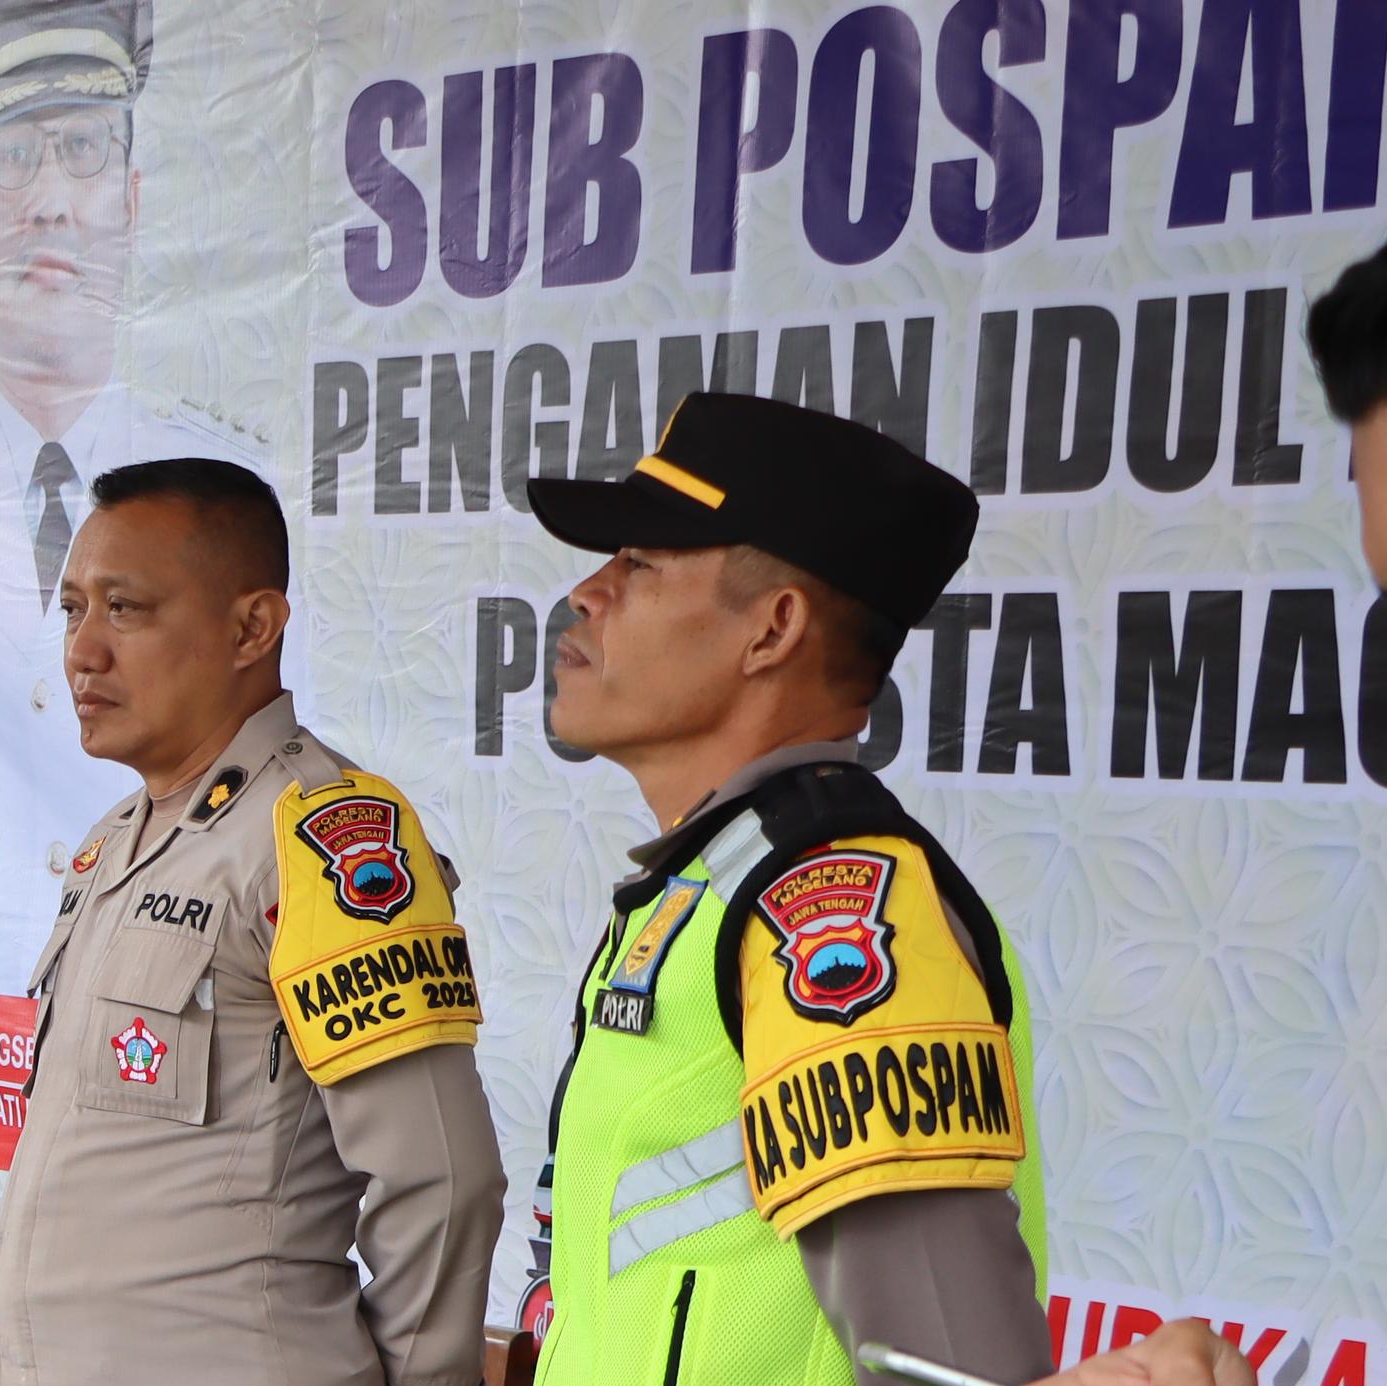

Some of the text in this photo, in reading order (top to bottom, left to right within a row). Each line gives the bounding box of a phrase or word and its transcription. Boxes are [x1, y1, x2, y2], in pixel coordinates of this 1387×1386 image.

[342, 51, 644, 308] SUB
[971, 288, 1304, 497] IDUL
[312, 807, 384, 832] POLRESTA
[771, 864, 873, 902] POLRESTA
[779, 875, 867, 906] MAGELANG
[134, 892, 214, 932] POLRI
[788, 898, 865, 926] JAWA TENGAH
[292, 938, 445, 1022] KARENDAL
[324, 981, 477, 1041] OKC 2025
[601, 993, 646, 1032] POLRI
[743, 1040, 1012, 1195] KA SUBPOSPAM
